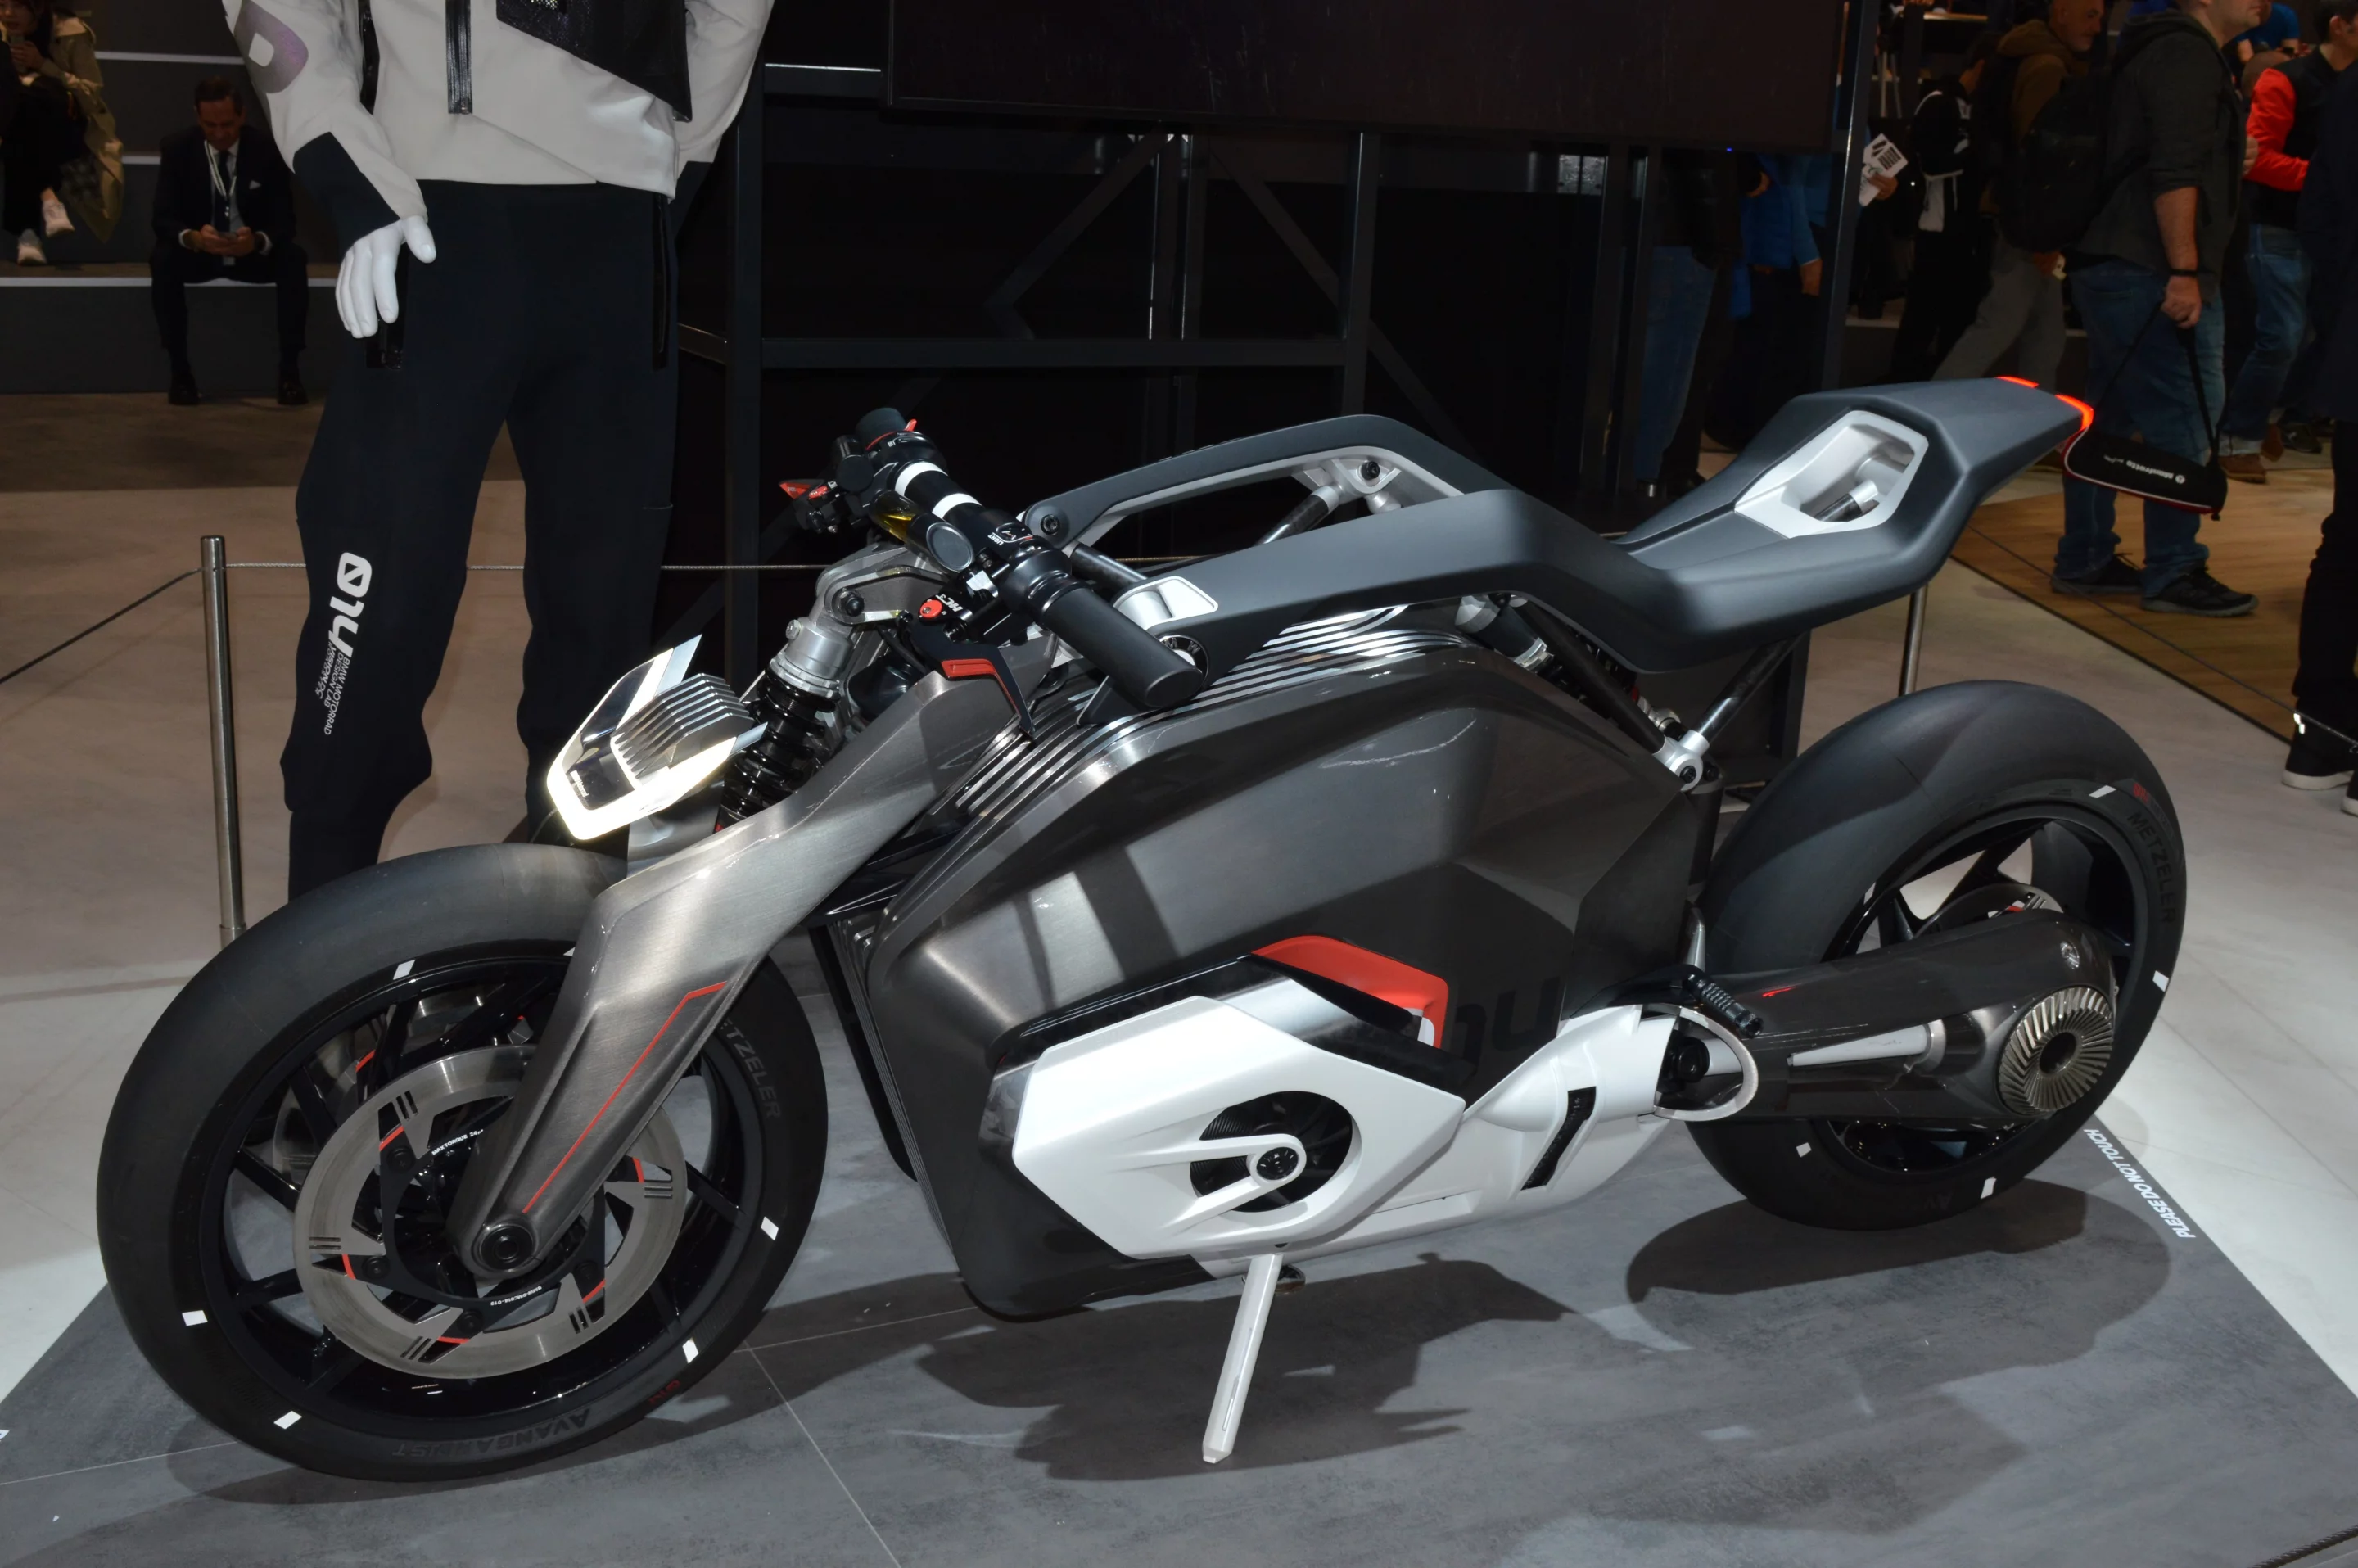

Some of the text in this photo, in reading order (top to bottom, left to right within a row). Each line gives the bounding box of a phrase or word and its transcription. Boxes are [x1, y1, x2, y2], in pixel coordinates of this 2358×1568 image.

[987, 531, 1005, 546] LIGHT
[324, 652, 345, 708] DESIGN LAB
[324, 657, 351, 735] BMW MOTORRAD
[2127, 810, 2176, 924] METZELER
[2083, 1129, 2197, 1238] PLEASE DO NOT TOUCH
